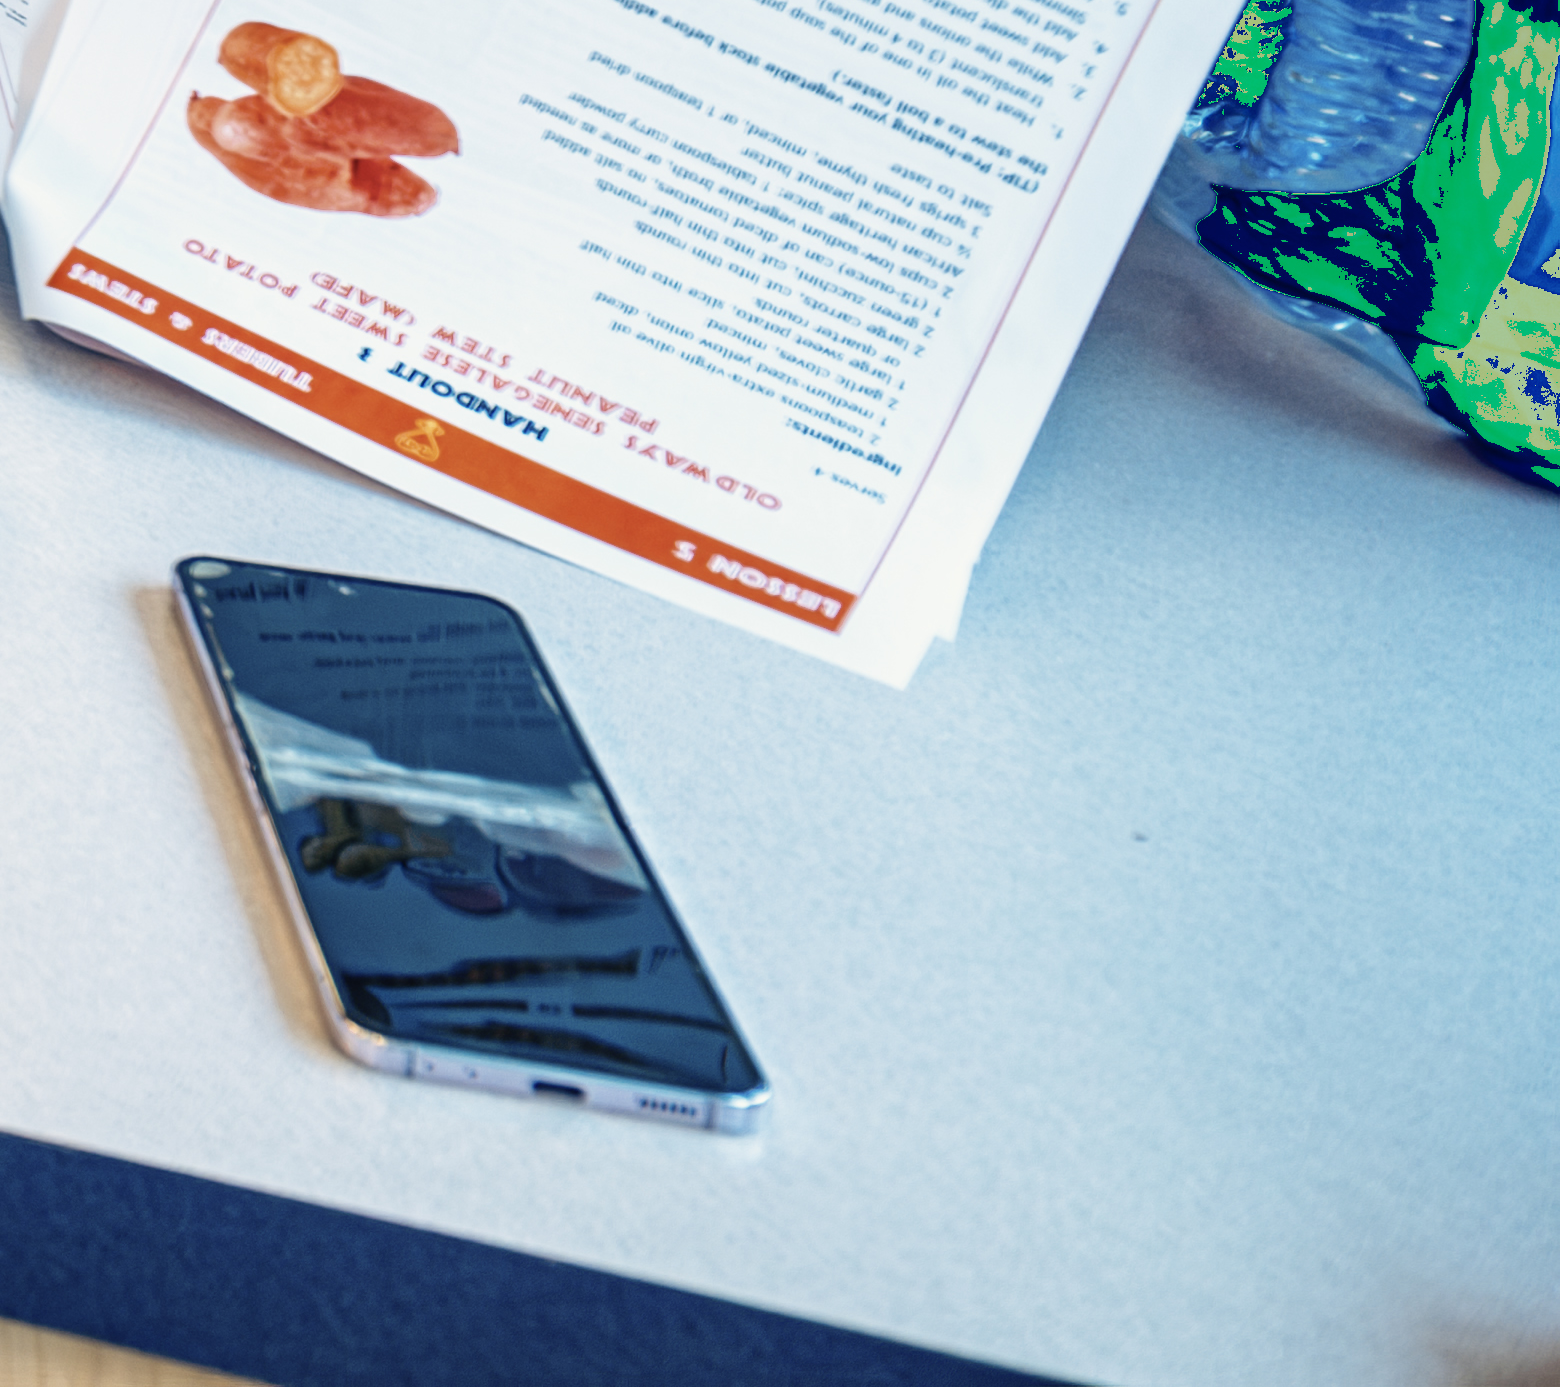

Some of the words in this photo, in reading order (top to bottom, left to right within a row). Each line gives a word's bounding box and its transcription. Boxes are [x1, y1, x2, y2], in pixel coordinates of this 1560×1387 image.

[661, 15, 715, 47] before
[718, 41, 760, 66] stock
[764, 63, 843, 104] vegetable
[849, 98, 887, 124] your
[891, 117, 992, 174] Pre-heating
[890, 164, 932, 189] taste
[935, 181, 955, 199] to
[960, 195, 991, 217] Salt
[635, 220, 687, 250] rounds
[184, 239, 299, 298] POTATO
[691, 247, 723, 267] thin
[67, 263, 159, 315] STEWS
[728, 263, 760, 284] into
[765, 278, 791, 298] cut
[311, 273, 414, 325] (MAFE)
[595, 292, 639, 316] diced
[800, 293, 862, 327] carrots,
[169, 311, 193, 331] &
[312, 298, 406, 347] SWEET
[609, 318, 631, 337] oil
[647, 313, 694, 340] onion,
[707, 319, 767, 350] minced
[431, 327, 511, 368] STEW
[635, 330, 674, 355] olive
[699, 339, 752, 365] yellow
[866, 325, 909, 351] large
[200, 327, 313, 392] TUBERS
[680, 351, 775, 397] extra-virgin
[776, 347, 831, 377] cloves,
[387, 362, 549, 442] HANDOUT
[423, 345, 605, 435] SENEGALESE
[528, 369, 658, 433] PEANUT
[756, 363, 874, 419] medium-sized
[835, 372, 881, 401] garlic
[781, 395, 864, 438] teaspoons
[789, 418, 902, 476] Ingredients:
[624, 435, 781, 509] OLDWAYS
[810, 463, 826, 478] 4
[831, 473, 885, 504] Serves
[673, 540, 697, 562] 5
[707, 554, 842, 619] LESSON
